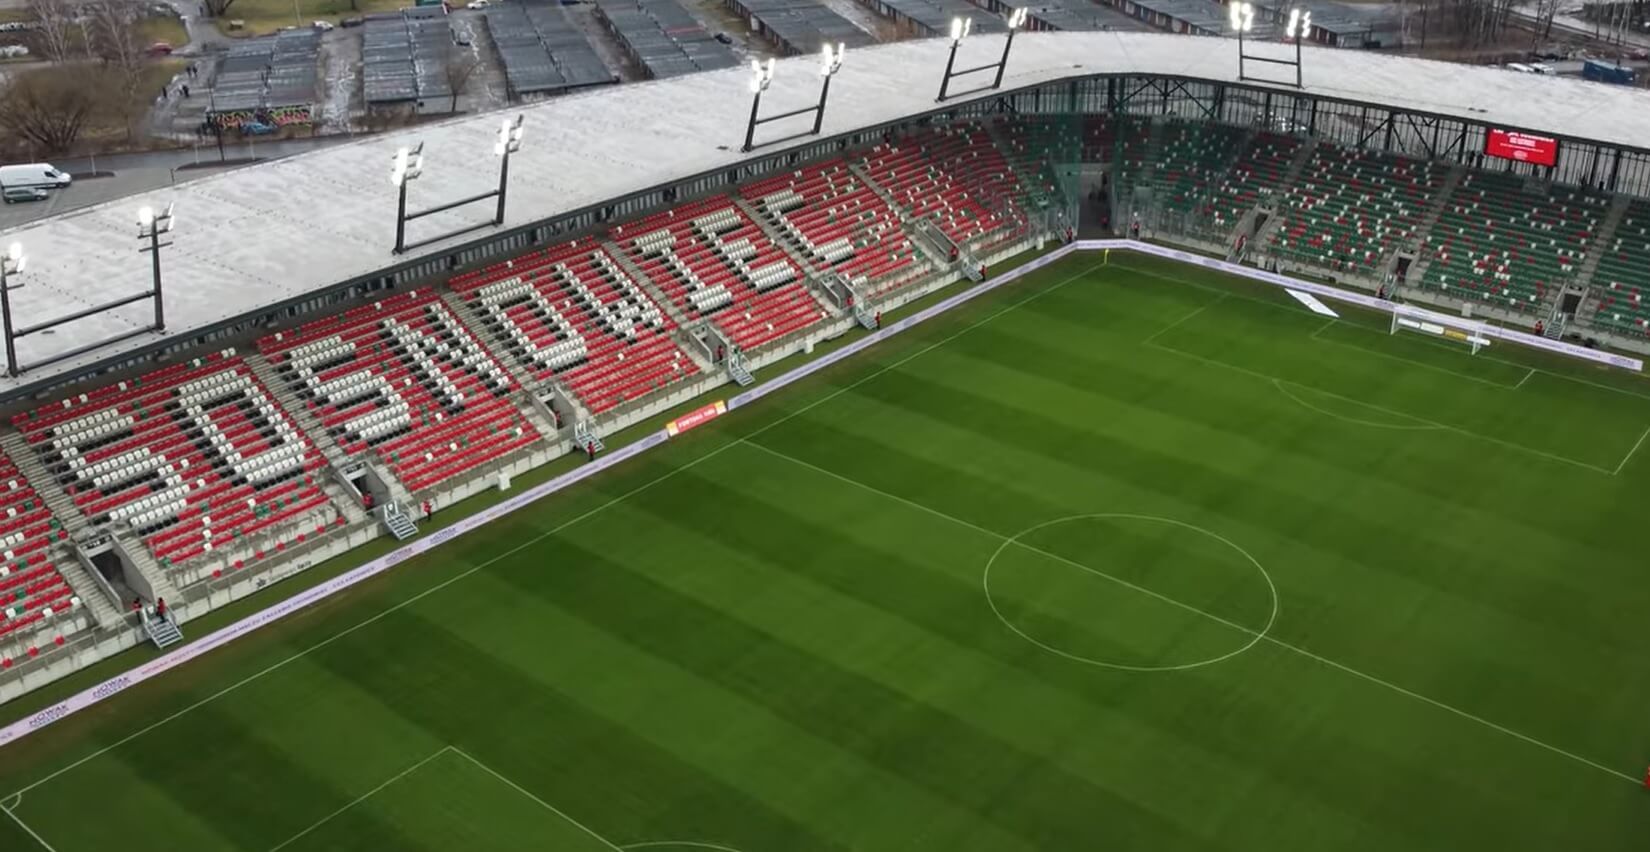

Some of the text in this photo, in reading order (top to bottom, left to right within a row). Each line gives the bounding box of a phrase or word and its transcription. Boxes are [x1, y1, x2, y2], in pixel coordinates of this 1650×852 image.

[46, 189, 853, 530] SOSNOWIEC
[93, 677, 129, 698] NOWAK
[29, 705, 67, 727] NOWAK
